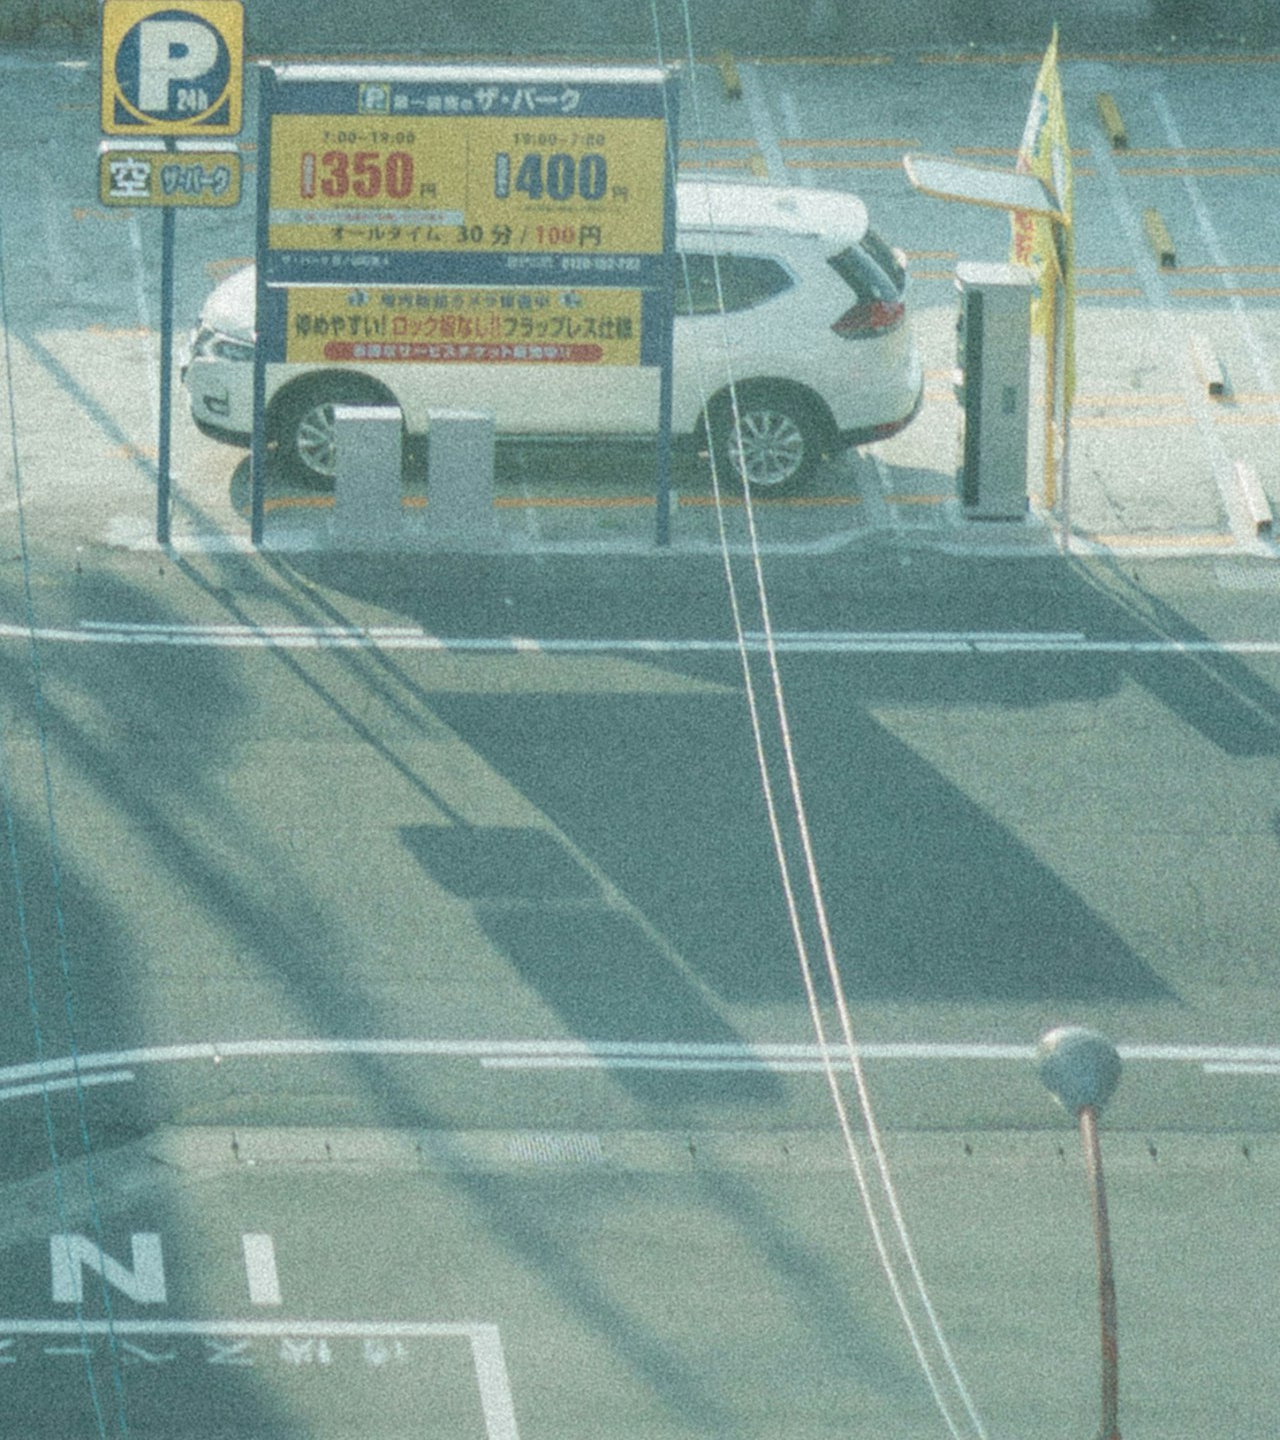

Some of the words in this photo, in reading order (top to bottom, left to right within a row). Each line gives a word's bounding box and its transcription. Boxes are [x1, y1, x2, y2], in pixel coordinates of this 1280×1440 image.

[137, 20, 220, 111] P
[175, 88, 209, 111] 24h
[108, 160, 152, 198] 空
